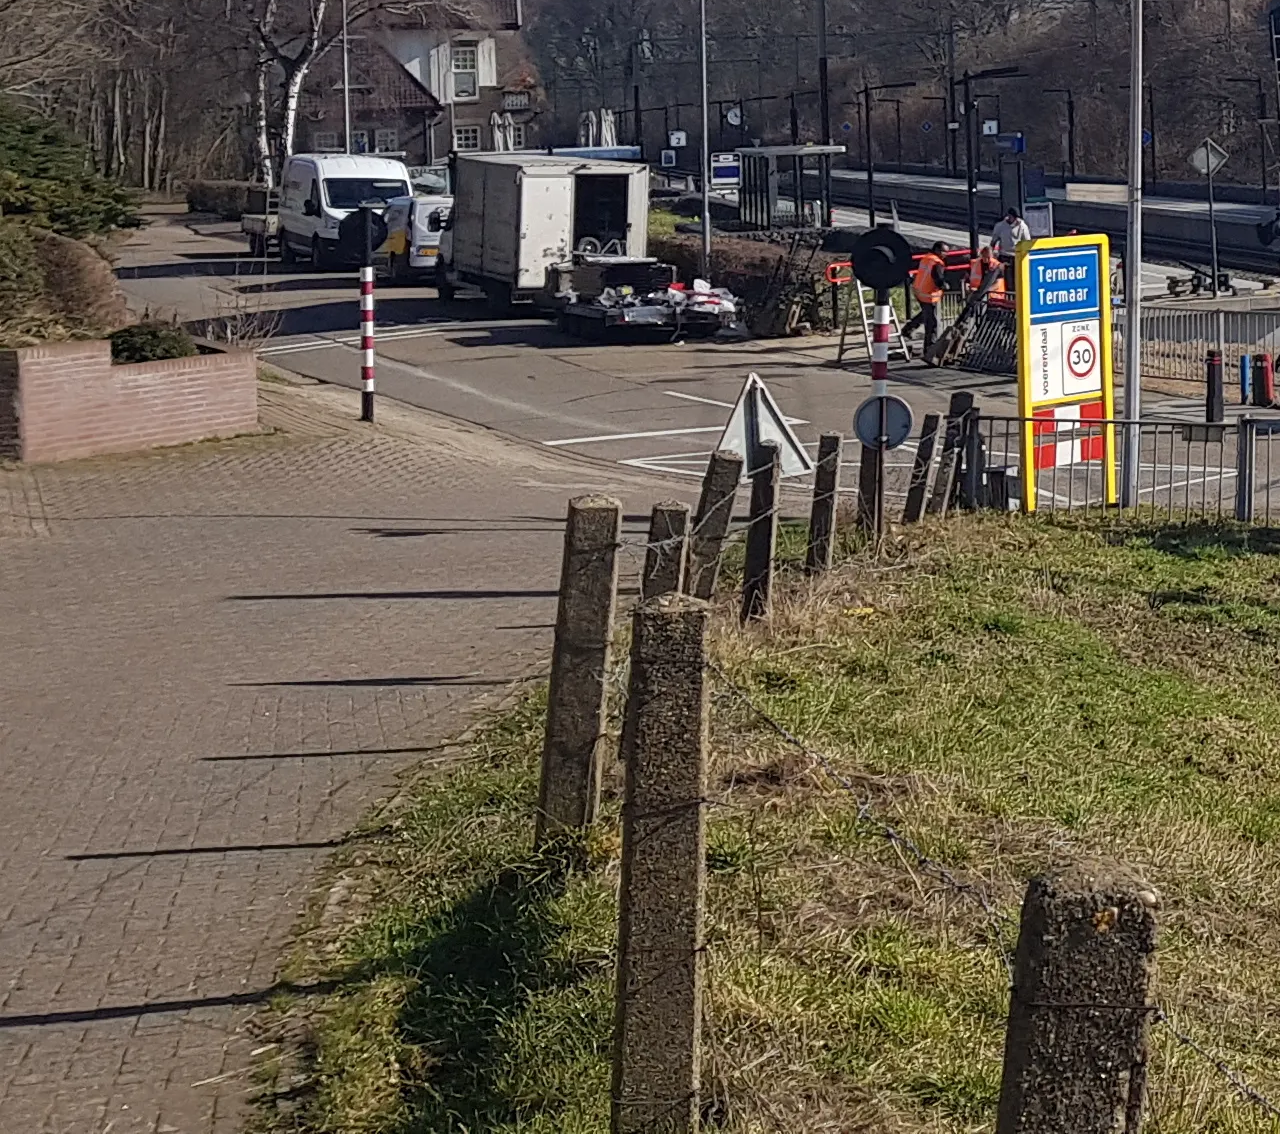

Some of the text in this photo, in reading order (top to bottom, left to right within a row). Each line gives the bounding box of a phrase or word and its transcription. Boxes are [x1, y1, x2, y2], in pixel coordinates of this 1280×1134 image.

[1037, 266, 1088, 283] Termaar
[1038, 288, 1089, 306] Termaar
[1072, 324, 1090, 333] ZONE
[1040, 328, 1049, 396] voerendaal
[1072, 348, 1092, 366] 30
